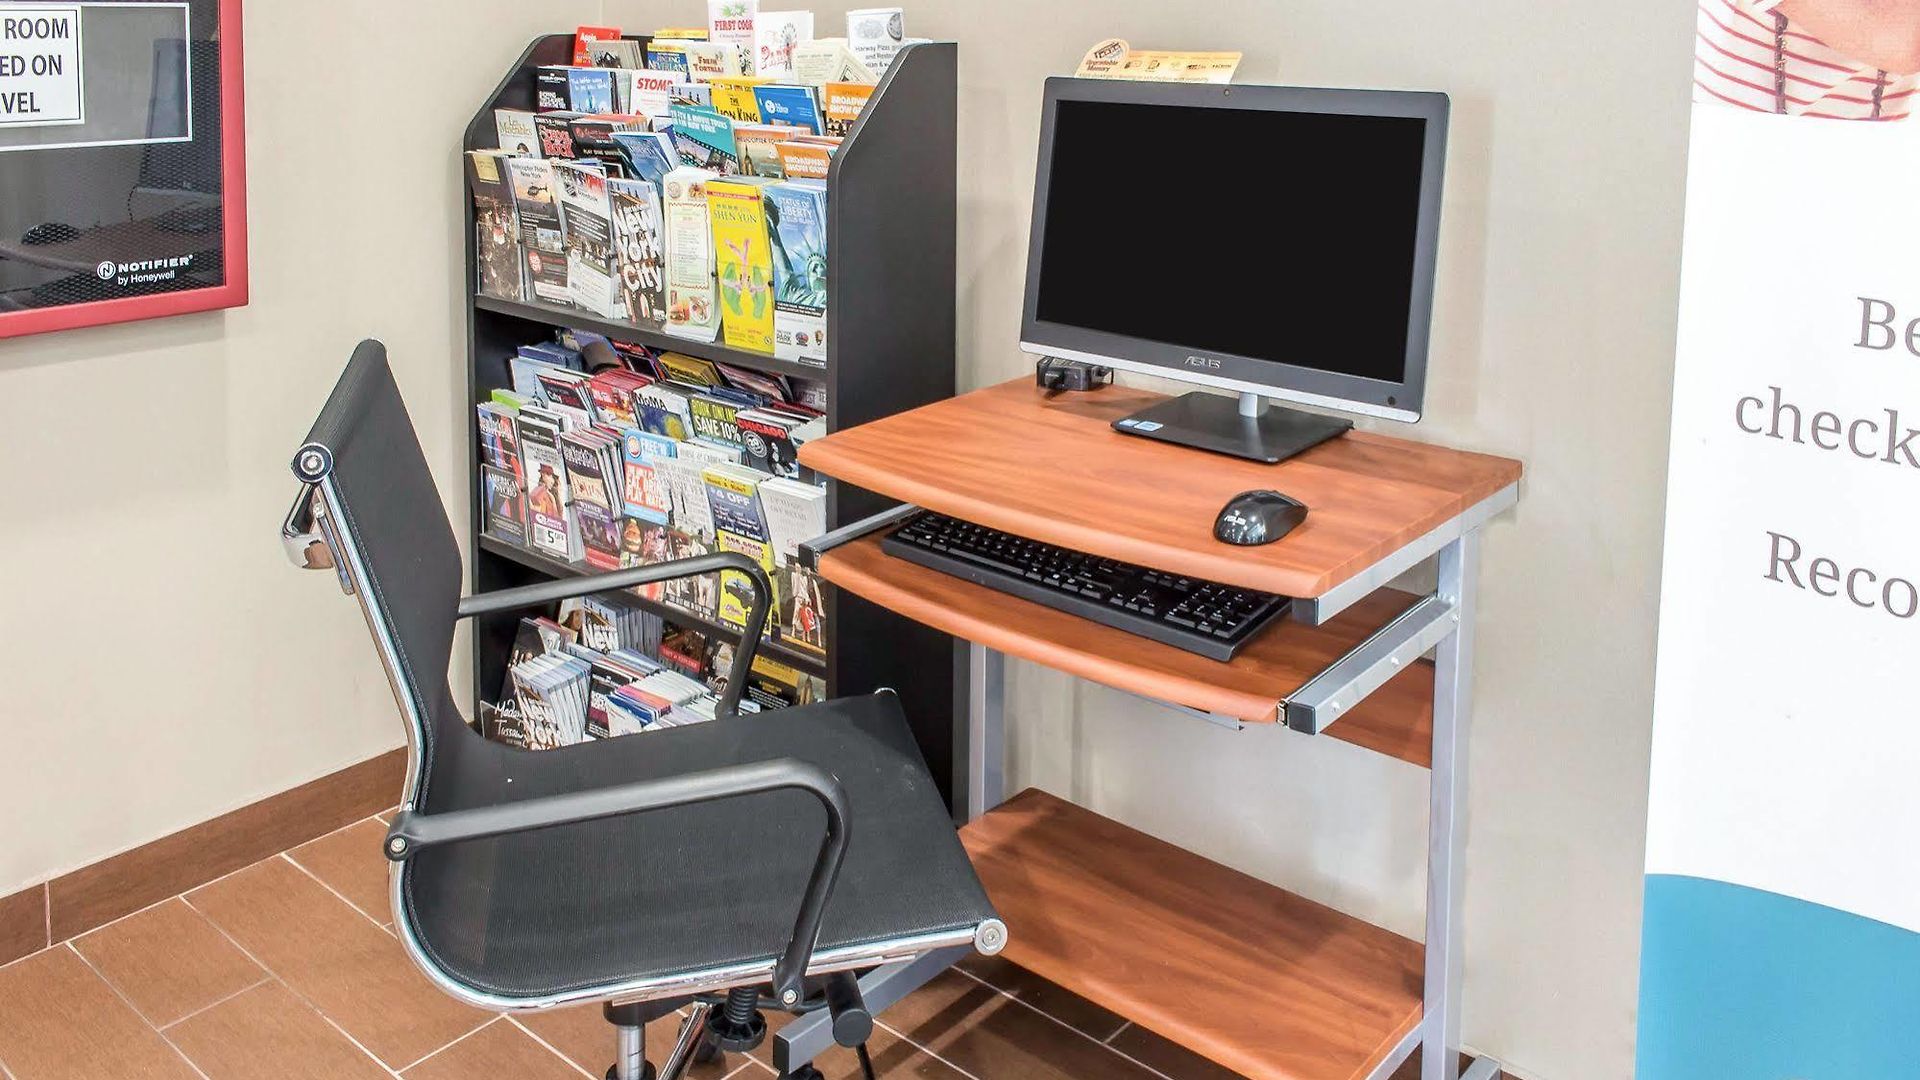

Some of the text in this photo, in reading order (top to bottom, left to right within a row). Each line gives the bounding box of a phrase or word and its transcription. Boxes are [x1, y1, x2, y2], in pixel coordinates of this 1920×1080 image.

[4, 18, 69, 39] ROOM
[714, 19, 754, 31] FIRST COOK
[31, 54, 62, 76] ON
[637, 78, 673, 91] STOMP
[0, 91, 40, 114] VEL
[736, 106, 758, 123] KING
[118, 256, 190, 273] NOTIFIER
[118, 270, 175, 285] by Honeywell
[622, 264, 663, 293] City
[1184, 355, 1221, 368] ASUS
[636, 393, 667, 411] MoMA
[692, 399, 737, 423] BOOK ONLINE
[696, 418, 742, 442] SAVE 10%
[736, 418, 787, 439] CHICAGO
[1735, 385, 1920, 469] check
[726, 492, 750, 506] OFF
[1223, 514, 1246, 525] ASUS
[1764, 531, 1919, 618] Reco
